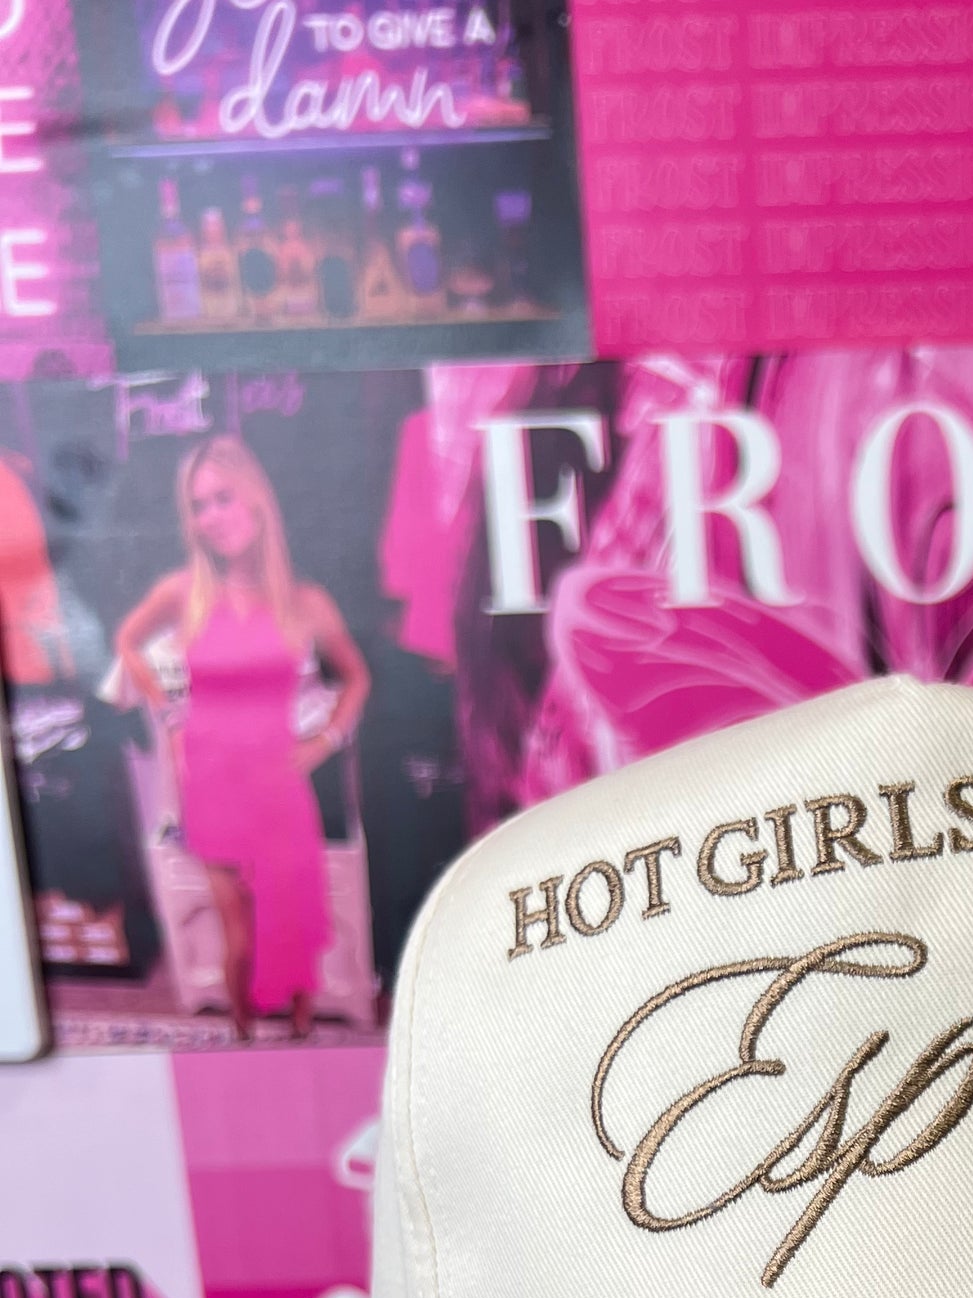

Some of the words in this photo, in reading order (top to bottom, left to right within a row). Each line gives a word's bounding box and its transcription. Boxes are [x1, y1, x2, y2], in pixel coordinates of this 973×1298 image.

[217, 0, 468, 139] damn
[303, 12, 364, 51] TO
[367, 7, 456, 50] GIVE
[463, 6, 496, 46] A
[507, 836, 682, 959] HOT
